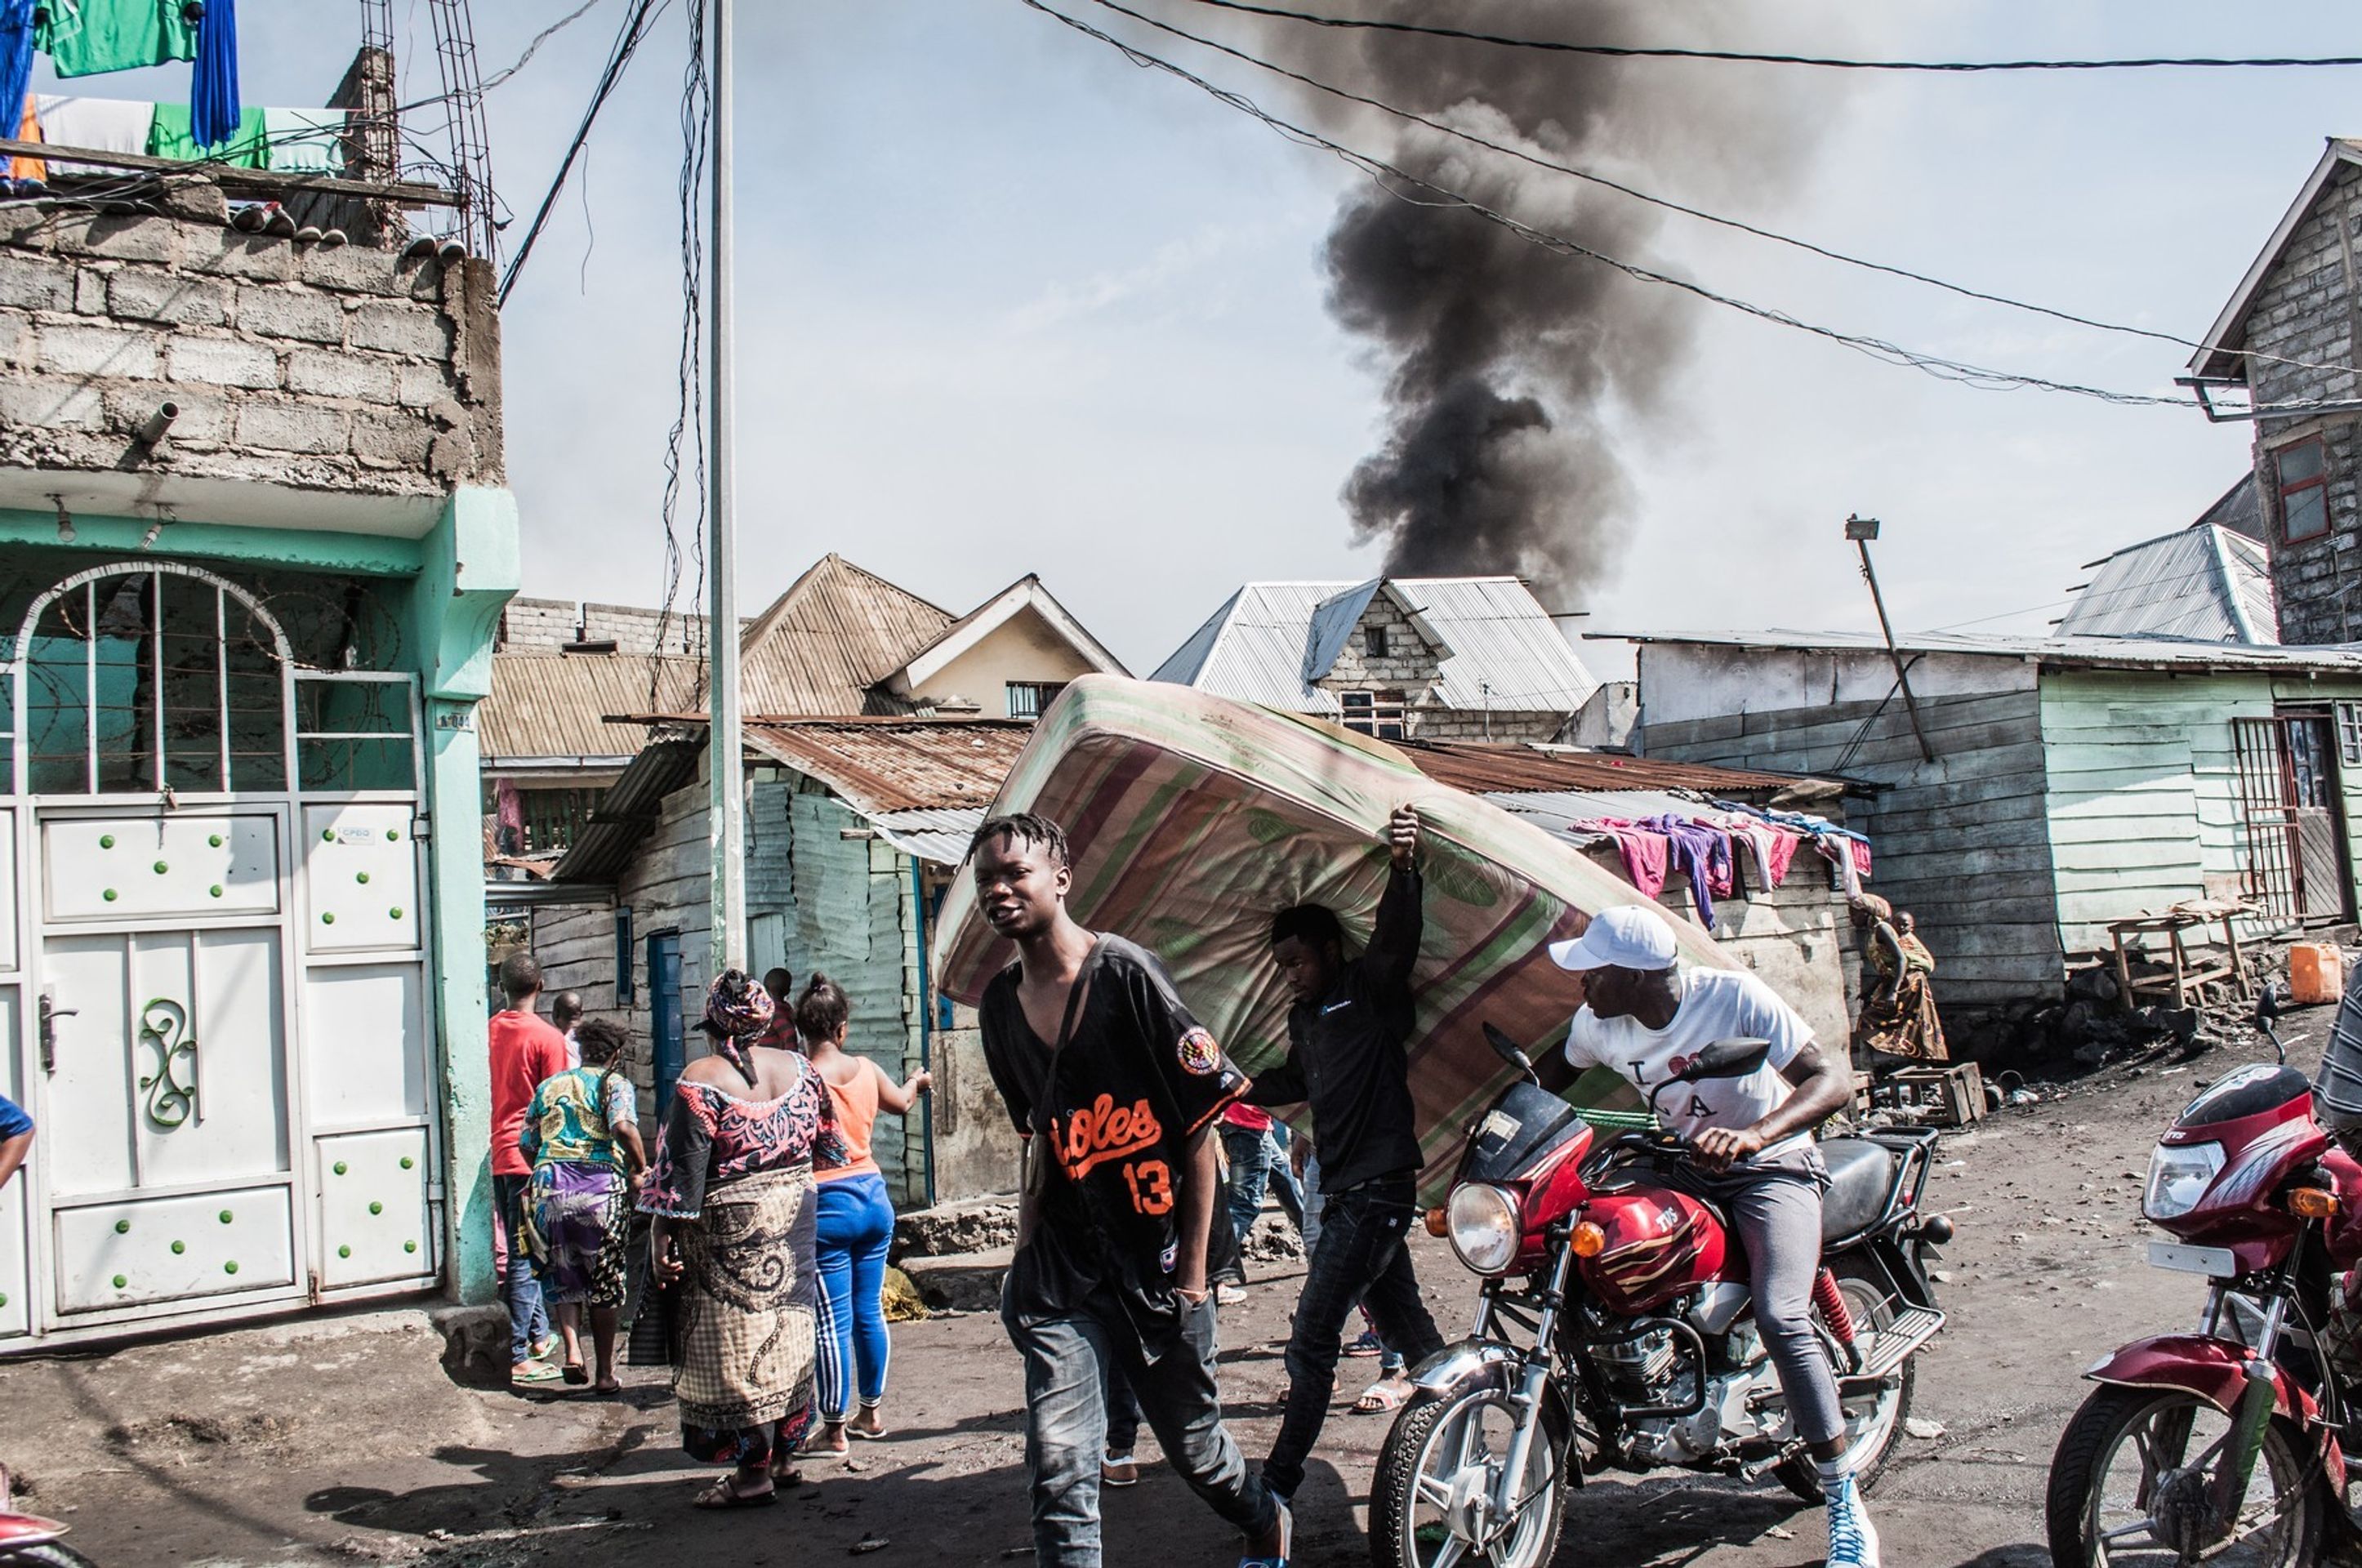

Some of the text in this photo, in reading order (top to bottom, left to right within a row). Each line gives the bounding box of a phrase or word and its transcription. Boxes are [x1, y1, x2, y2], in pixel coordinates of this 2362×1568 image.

[1628, 1060, 1651, 1085] I
[1123, 1160, 1174, 1215] 13
[1655, 1206, 1678, 1233] TVS
